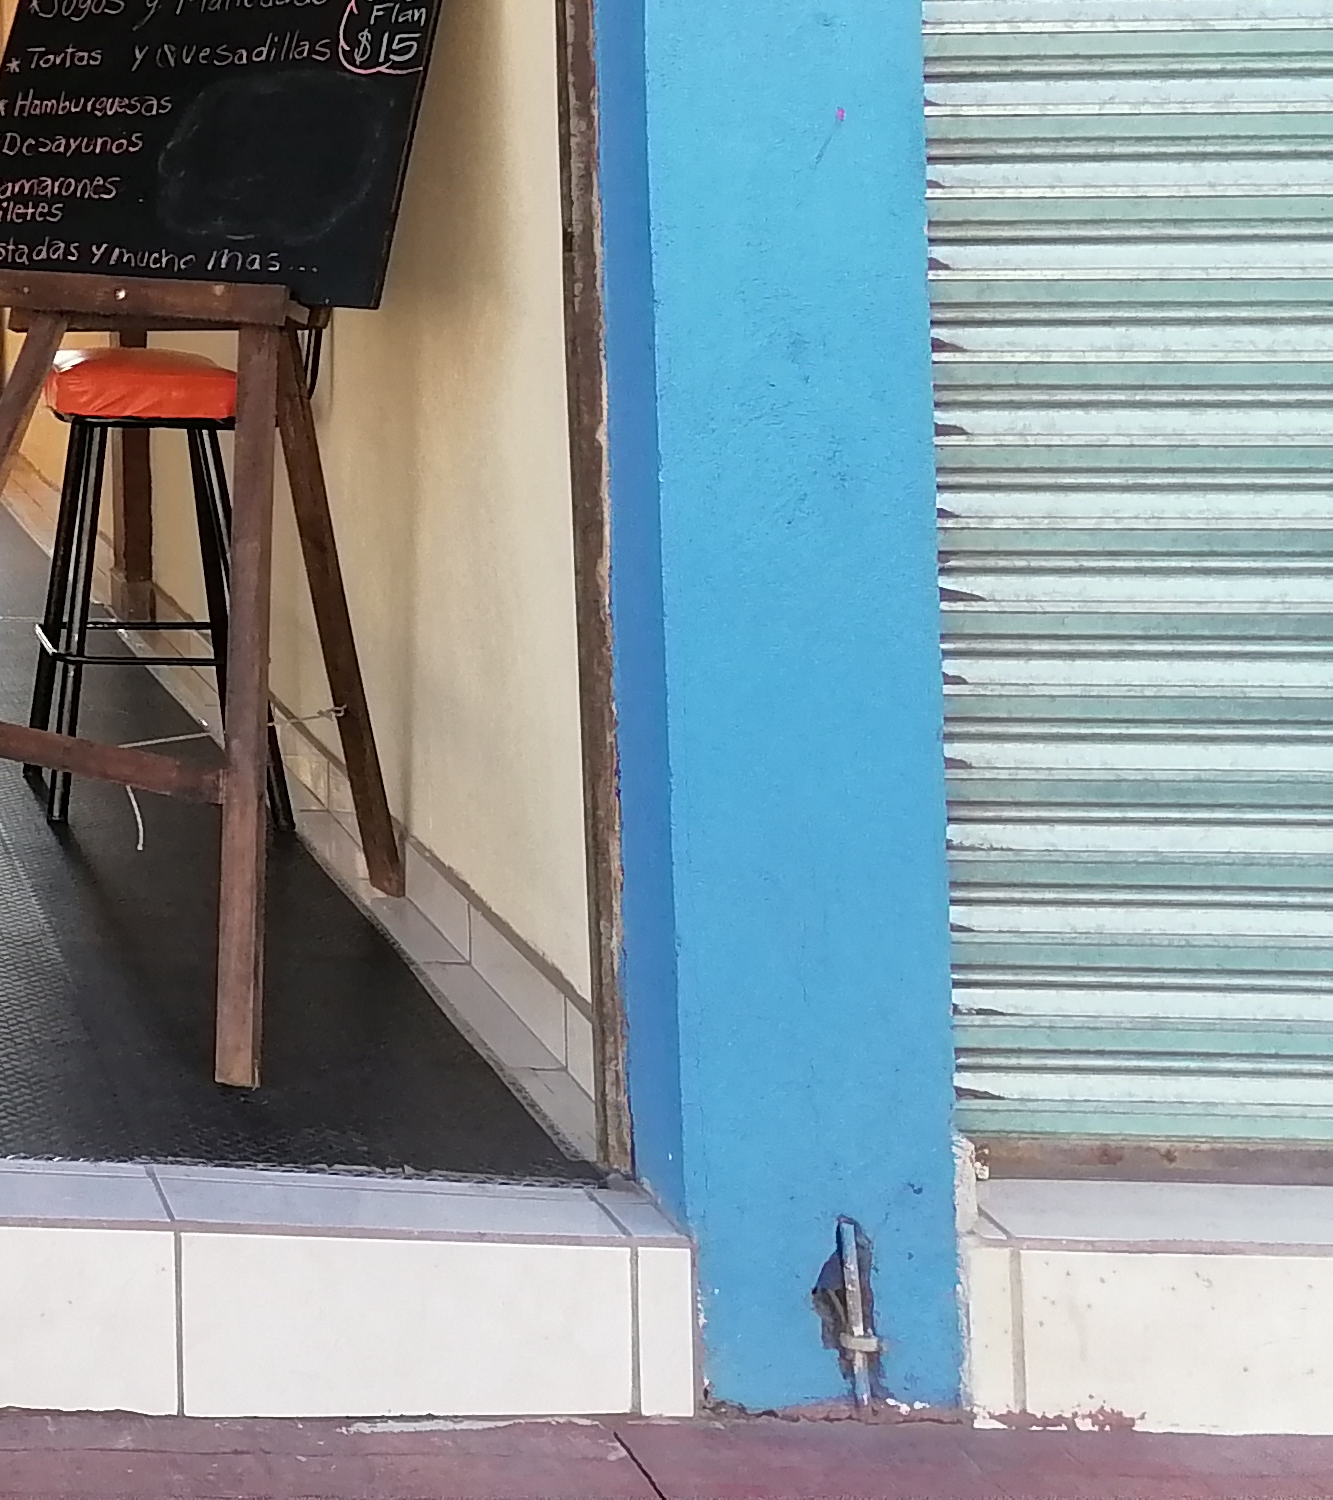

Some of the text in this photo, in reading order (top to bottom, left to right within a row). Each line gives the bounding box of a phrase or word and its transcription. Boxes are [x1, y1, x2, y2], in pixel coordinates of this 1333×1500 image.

[369, 2, 427, 26] Flan
[26, 45, 103, 70] Tortas
[131, 46, 148, 72] y
[353, 29, 423, 66] $15
[13, 88, 173, 118] Hamburguesas
[2, 132, 144, 158] Desayunos
[91, 243, 109, 266] y
[109, 246, 196, 273] mucho
